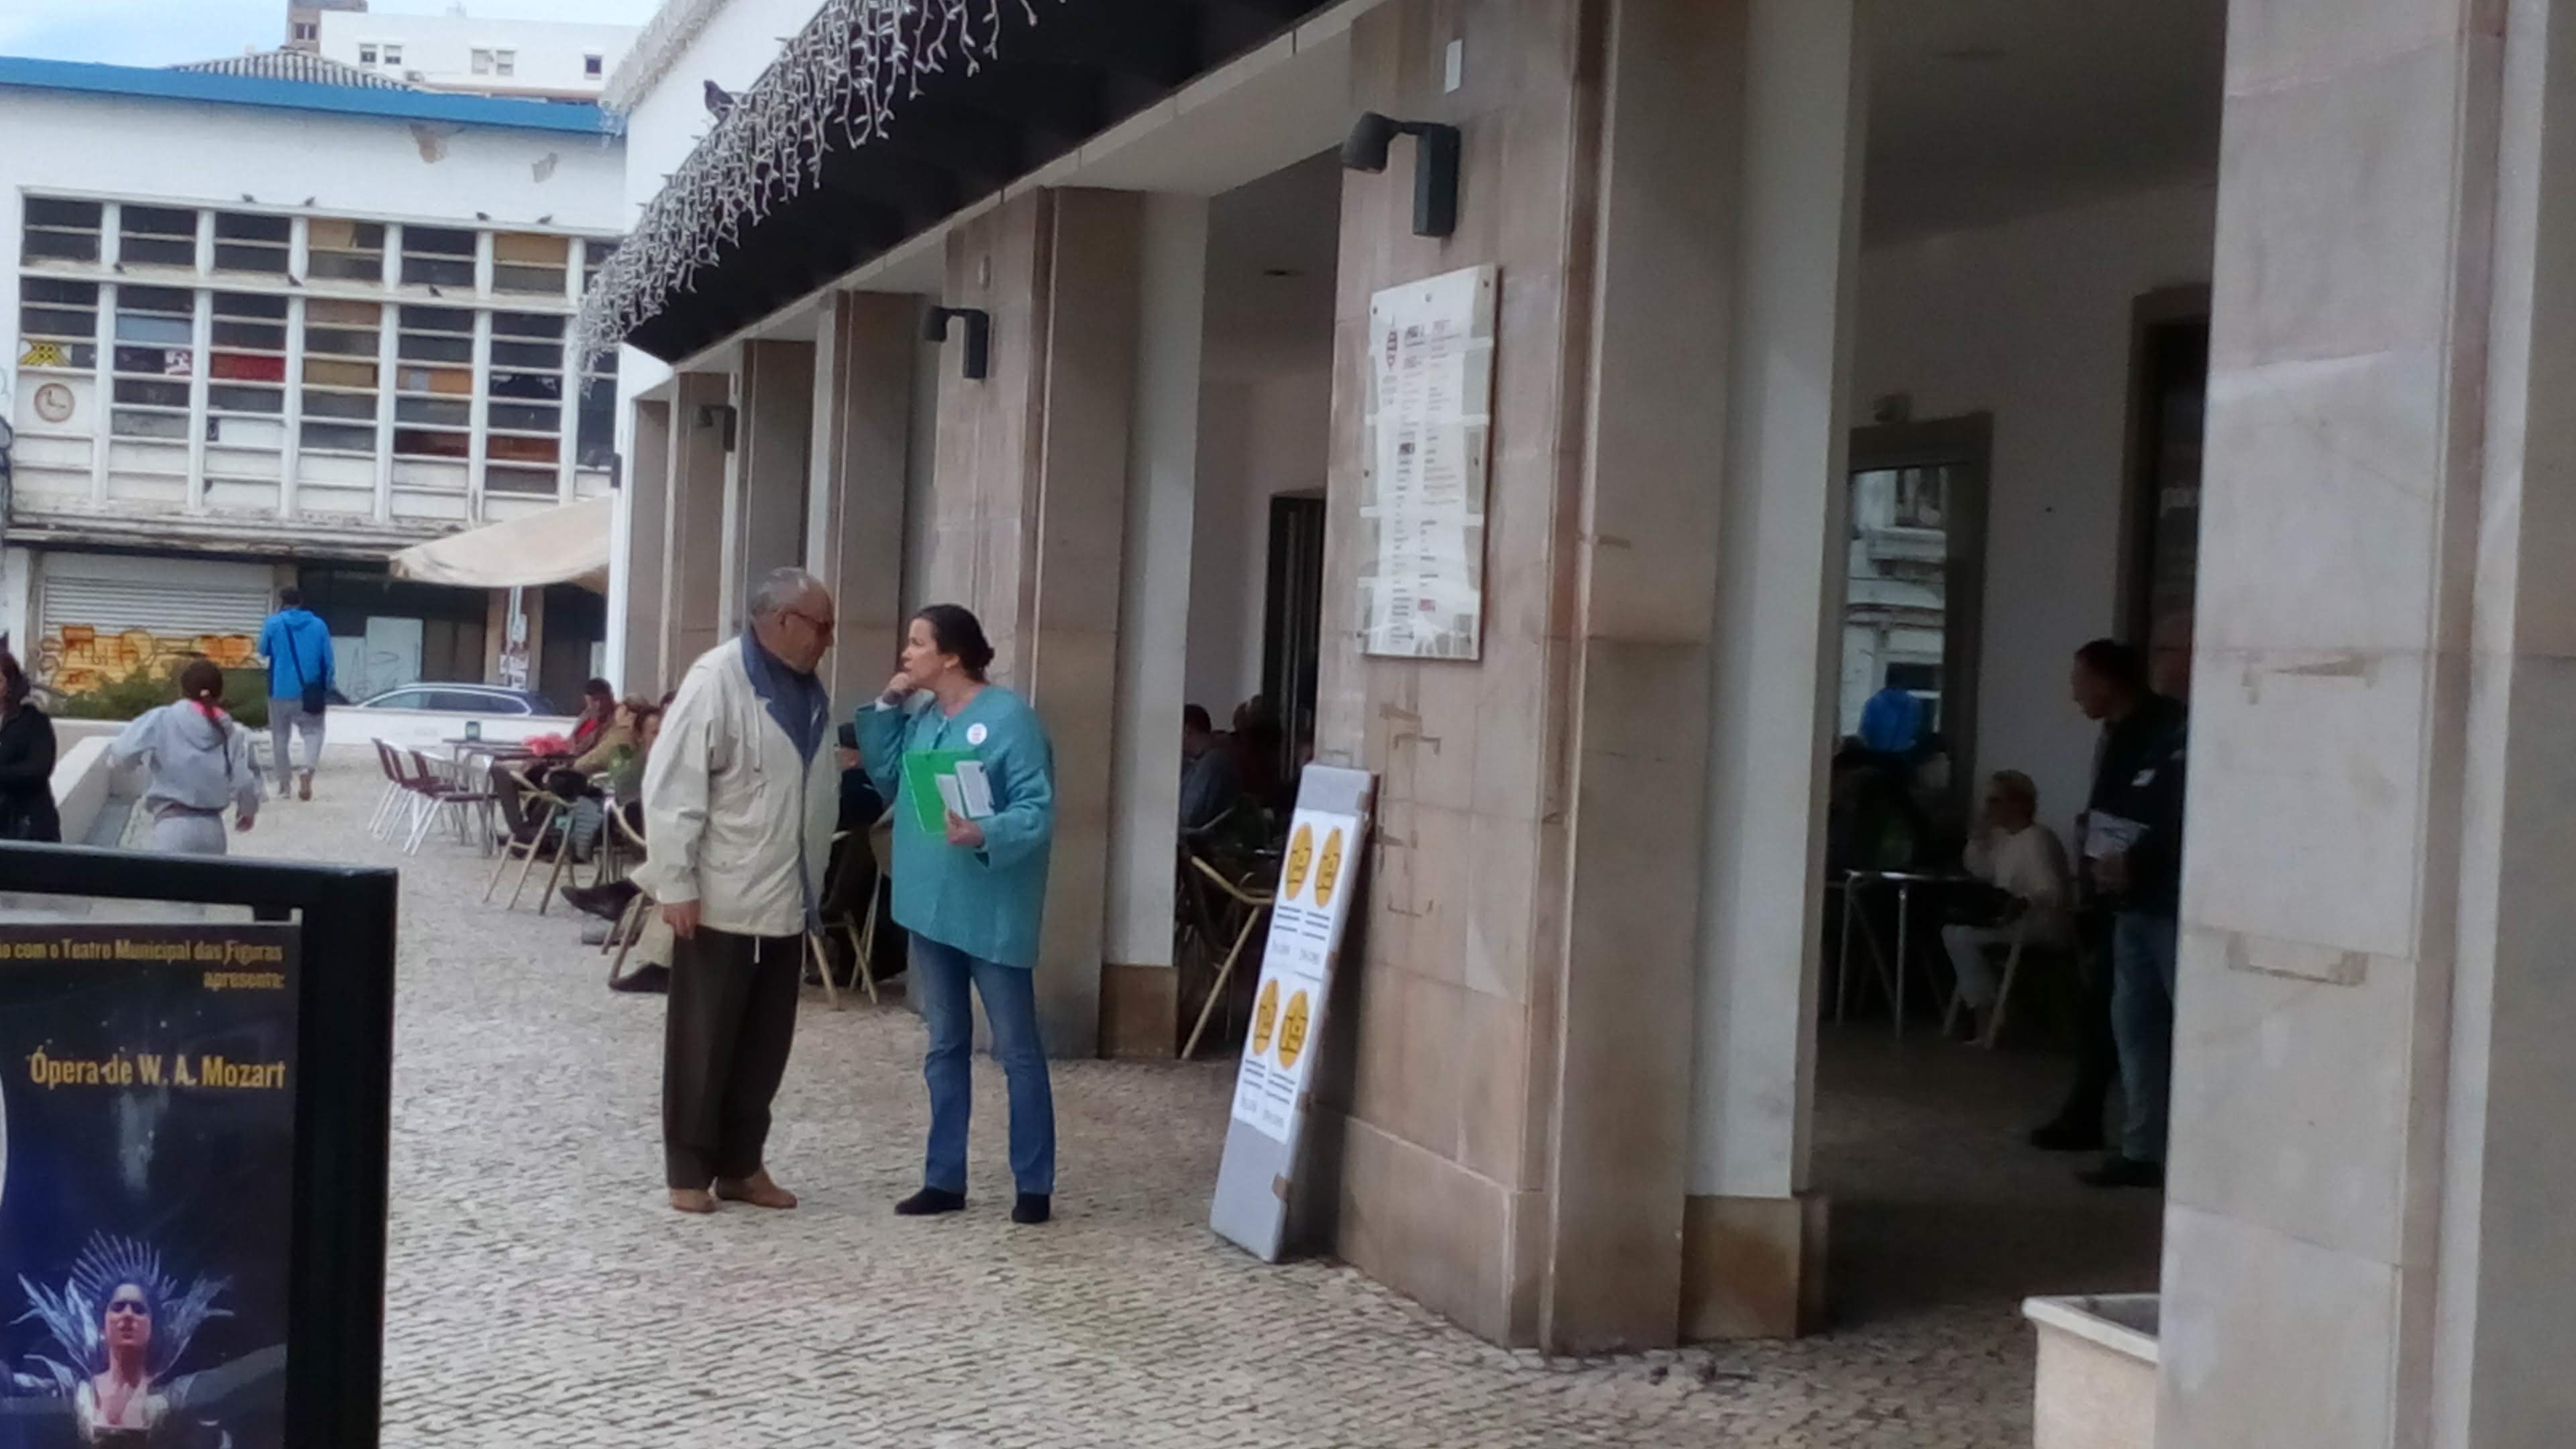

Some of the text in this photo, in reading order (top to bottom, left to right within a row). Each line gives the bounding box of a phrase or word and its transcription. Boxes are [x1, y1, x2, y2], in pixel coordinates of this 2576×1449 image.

[15, 943, 47, 959] com
[50, 943, 59, 959] o
[61, 938, 112, 959] Teatro
[115, 939, 191, 964] Municipal
[193, 940, 223, 960] das
[223, 939, 282, 966] Figuras
[31, 1044, 100, 1090] Ópera
[138, 1054, 169, 1085] W.
[173, 1054, 197, 1086] A.
[202, 1055, 286, 1089] Mozart
